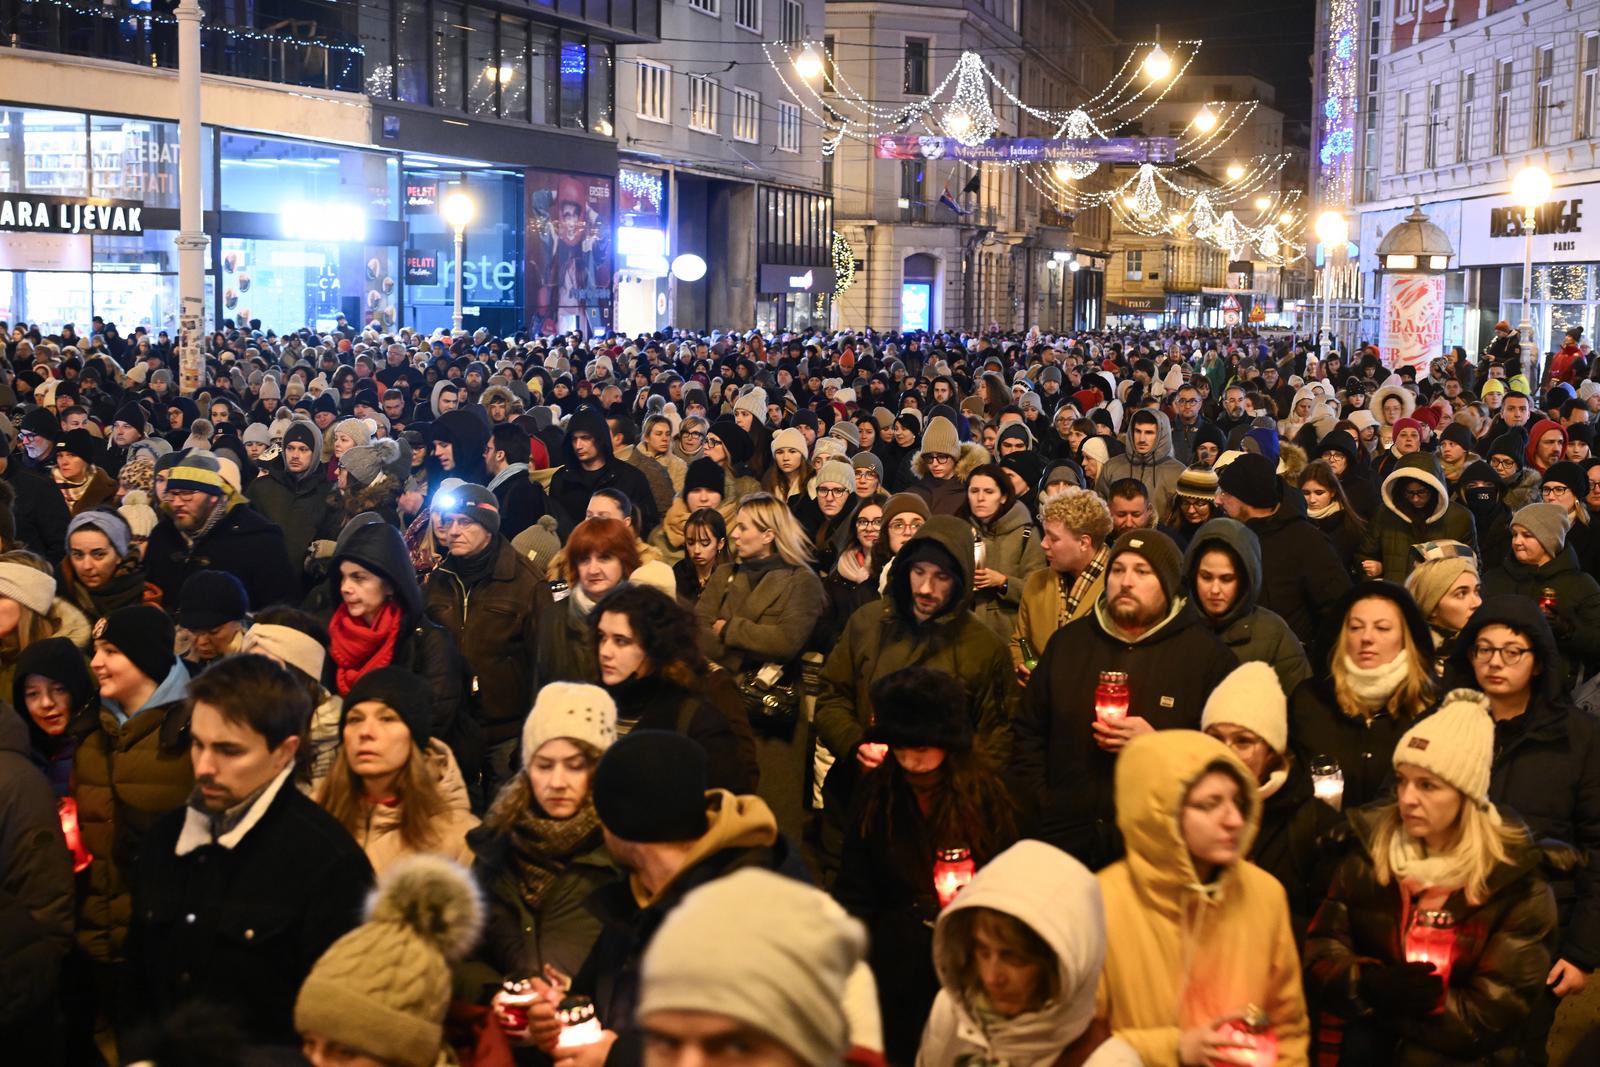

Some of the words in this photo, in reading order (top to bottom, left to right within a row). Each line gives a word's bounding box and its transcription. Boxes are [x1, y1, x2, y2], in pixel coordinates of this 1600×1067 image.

[0, 200, 50, 228] ARA
[60, 203, 142, 234] LJEVAK
[1554, 241, 1575, 251] PARIS
